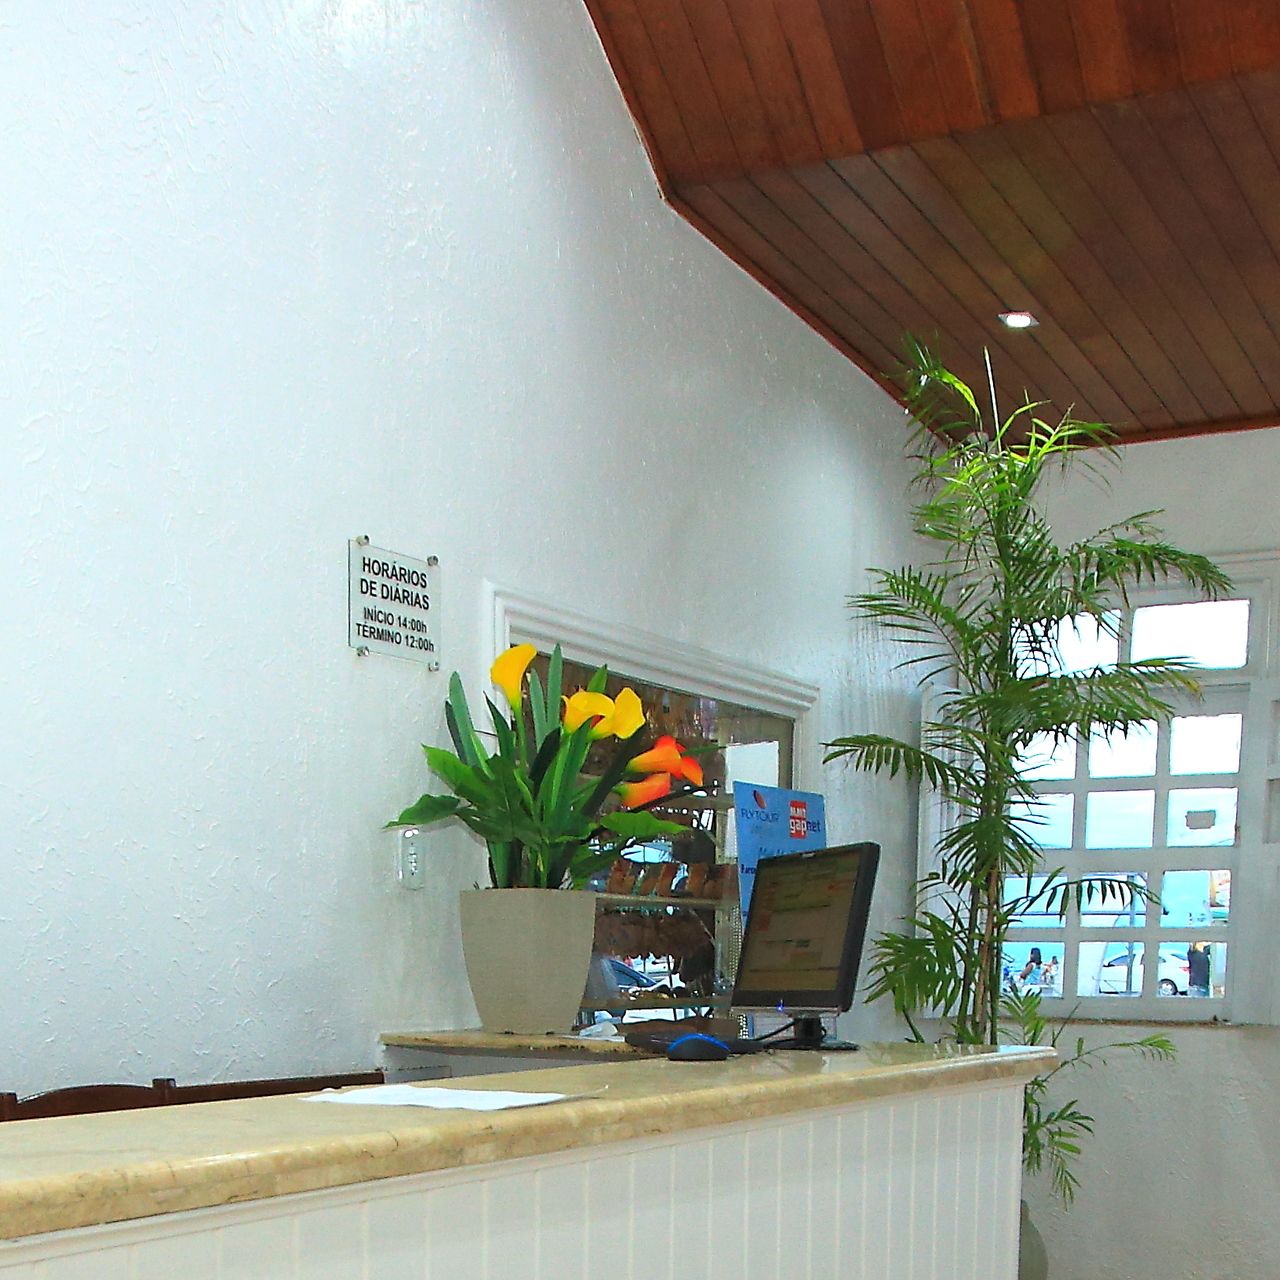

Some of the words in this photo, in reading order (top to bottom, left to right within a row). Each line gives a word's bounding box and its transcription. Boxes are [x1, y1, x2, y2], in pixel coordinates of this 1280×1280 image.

[362, 556, 427, 589] HORÁRIOS
[360, 578, 377, 597] DE
[381, 583, 430, 610] DIÁRIAS
[363, 605, 395, 626] INÍCIO
[398, 616, 427, 633] 14:00h
[355, 621, 402, 645] TÉRMINO
[405, 635, 434, 652] 12:00h
